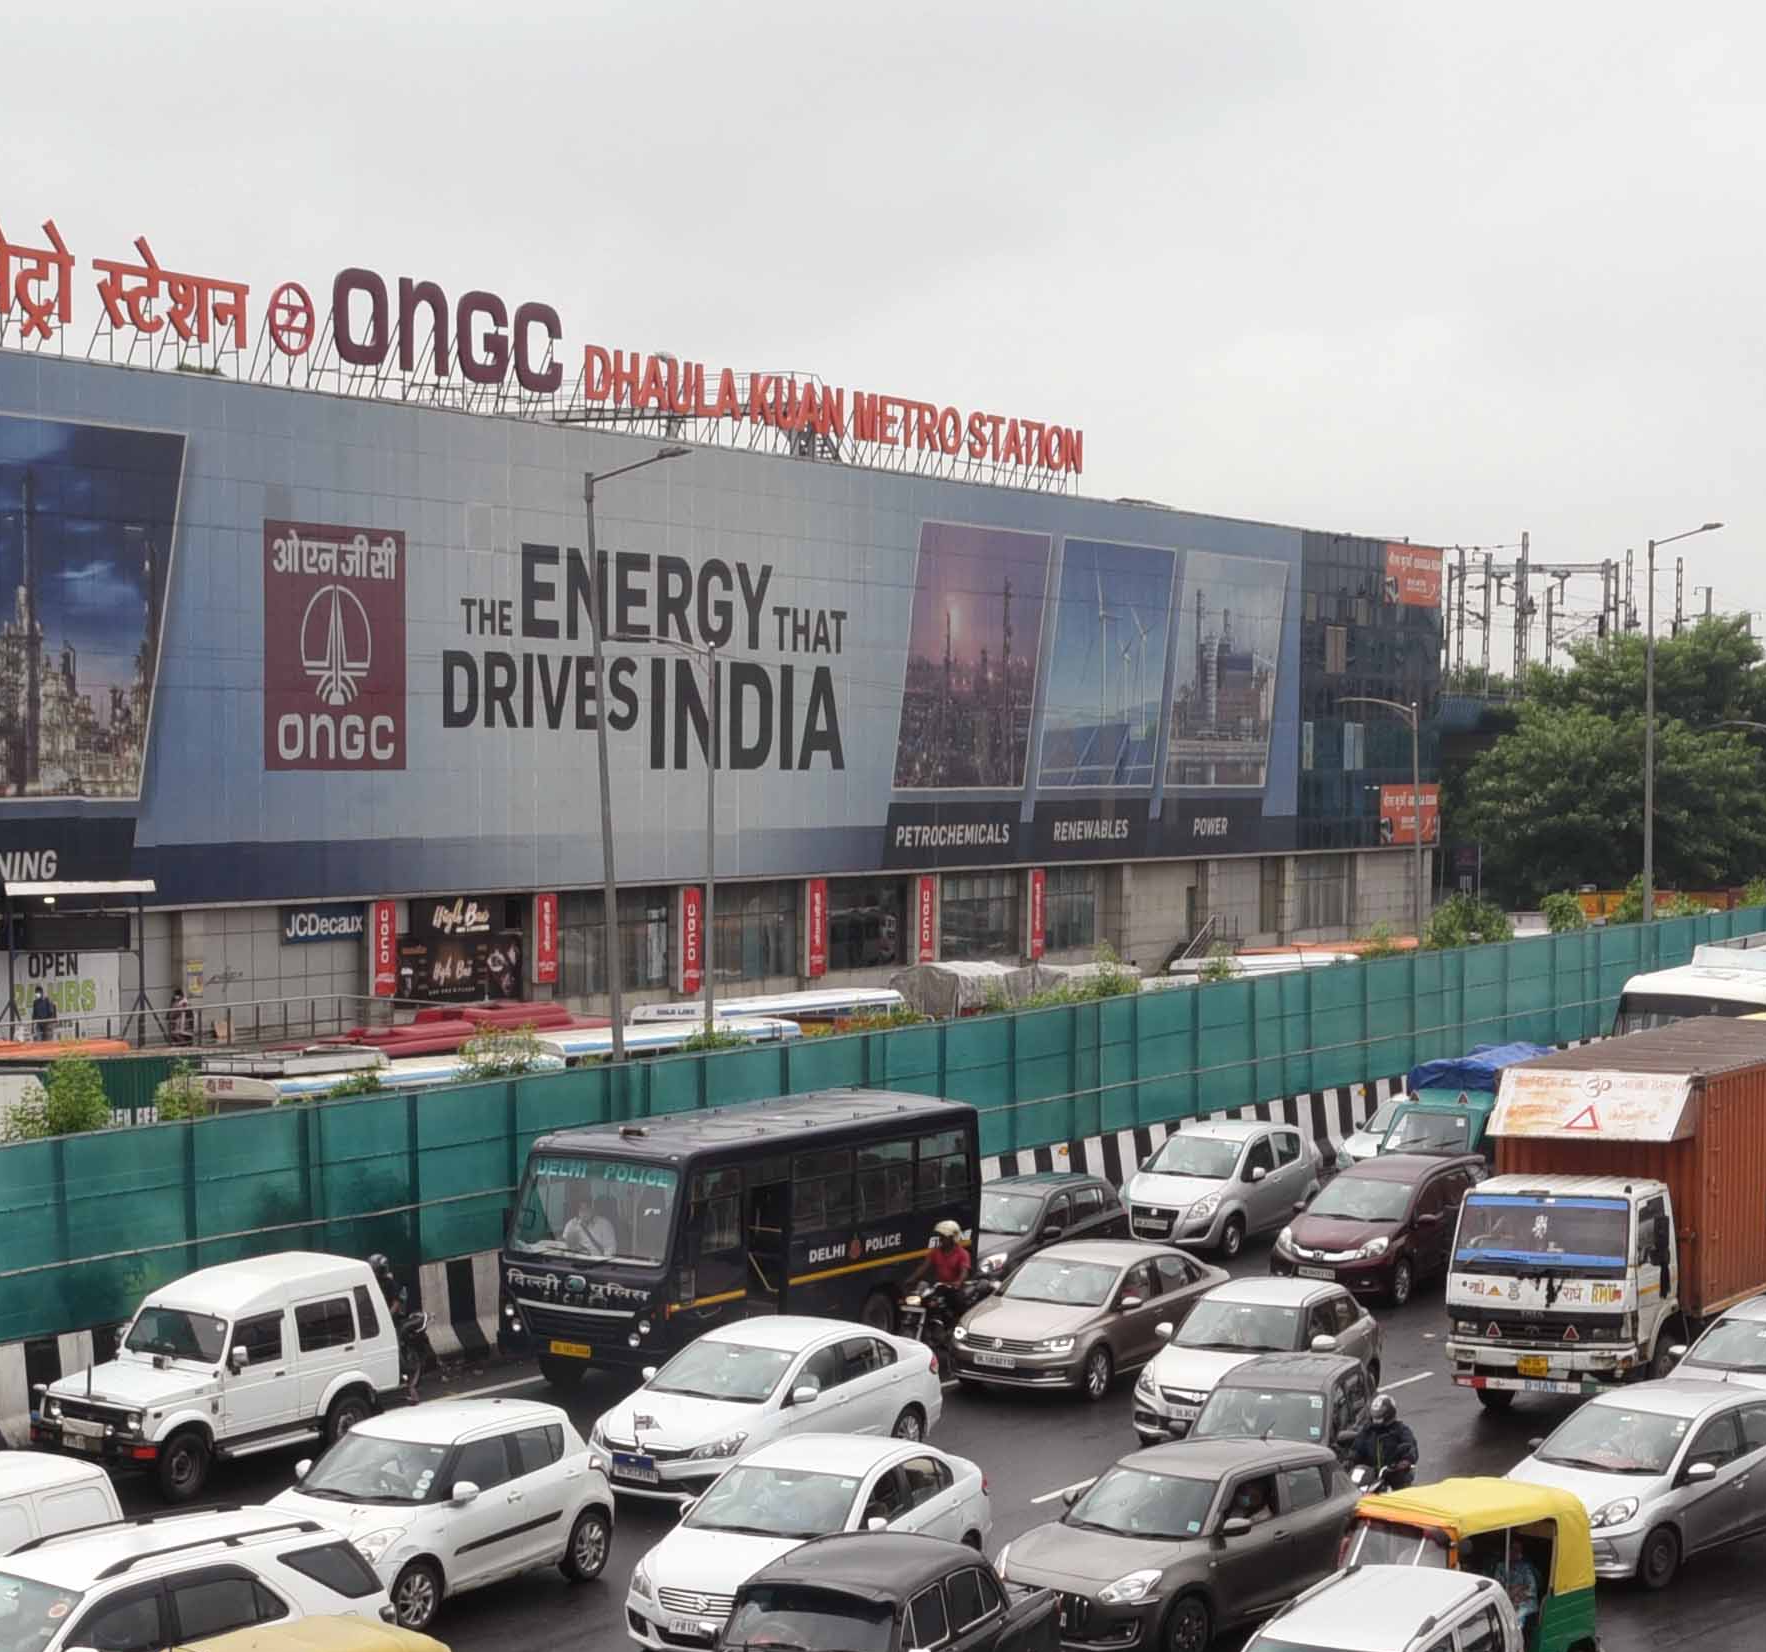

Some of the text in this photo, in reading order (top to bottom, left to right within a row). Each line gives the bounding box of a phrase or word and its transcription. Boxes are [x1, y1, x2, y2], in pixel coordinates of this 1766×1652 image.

[92, 236, 249, 349] स्टेशन
[584, 344, 1084, 475] DHAULA KUAN METRO STATION
[272, 528, 397, 581] ओएनजीसी
[461, 543, 847, 655] THE ENERGY THAT
[442, 649, 845, 770] DRIVES INDIA
[896, 823, 1010, 848] PETROCHEMICALS
[1053, 819, 1129, 842] RENEWABLES
[1193, 816, 1228, 837] POWER
[285, 912, 363, 939] JCDecaux
[28, 952, 78, 978] OPEN
[536, 1158, 670, 1188] DELHI POLICE
[809, 1233, 902, 1263] DELHI POLICE
[507, 1268, 560, 1291] दिल्ली
